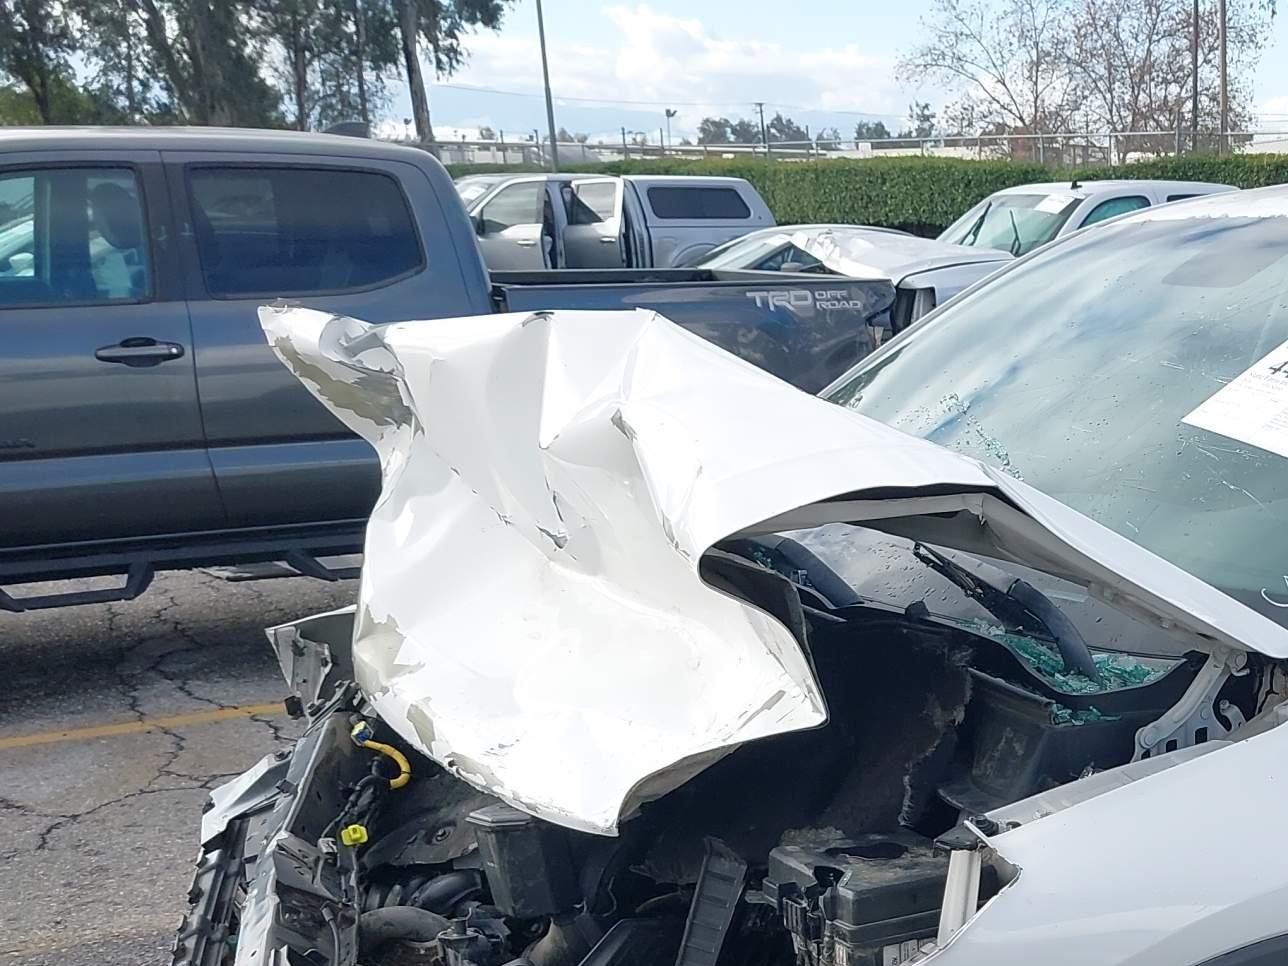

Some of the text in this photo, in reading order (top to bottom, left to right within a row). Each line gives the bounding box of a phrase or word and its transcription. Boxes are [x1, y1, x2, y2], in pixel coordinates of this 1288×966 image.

[746, 290, 849, 312] TRD OFF
[816, 300, 863, 309] ROAD
